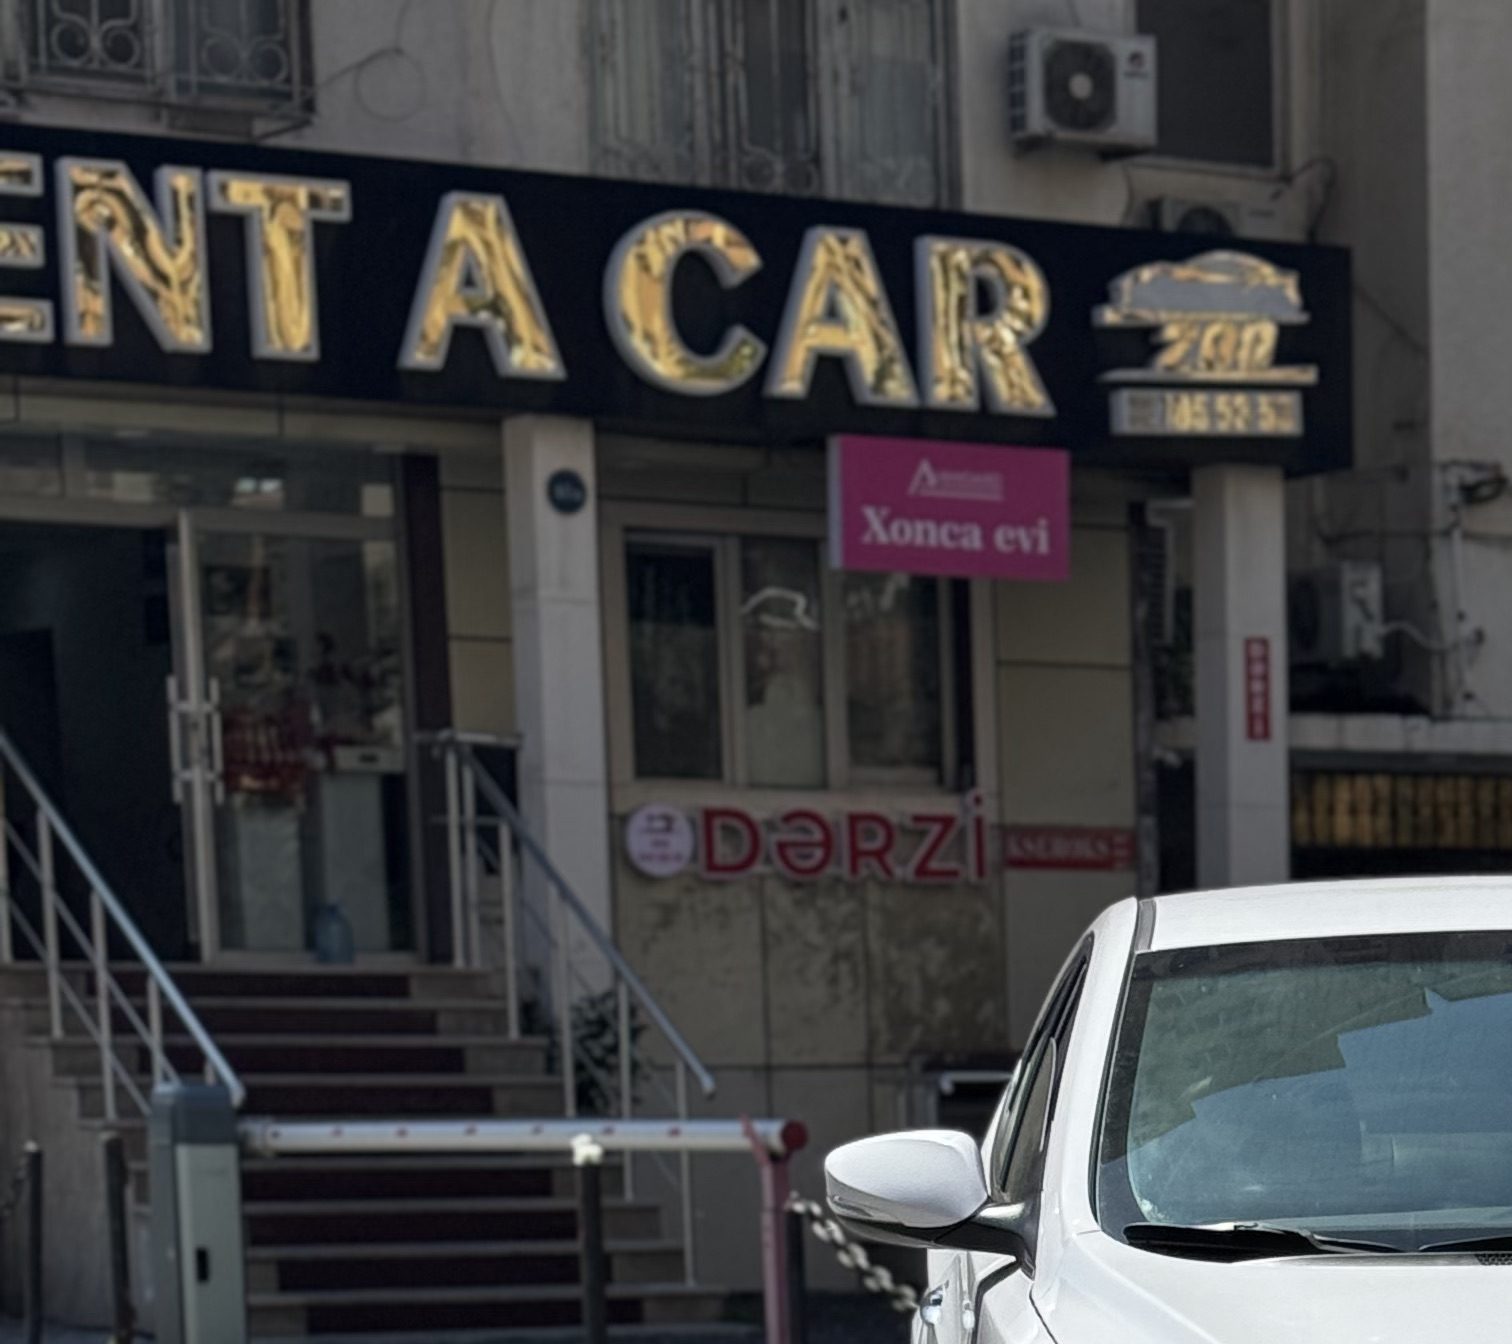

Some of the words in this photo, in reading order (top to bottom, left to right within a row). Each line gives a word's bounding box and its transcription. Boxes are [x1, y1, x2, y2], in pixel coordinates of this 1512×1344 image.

[397, 191, 568, 381] A
[602, 209, 1057, 417] CAR
[993, 517, 1051, 556] evi
[700, 788, 991, 884] DƏRZİ
